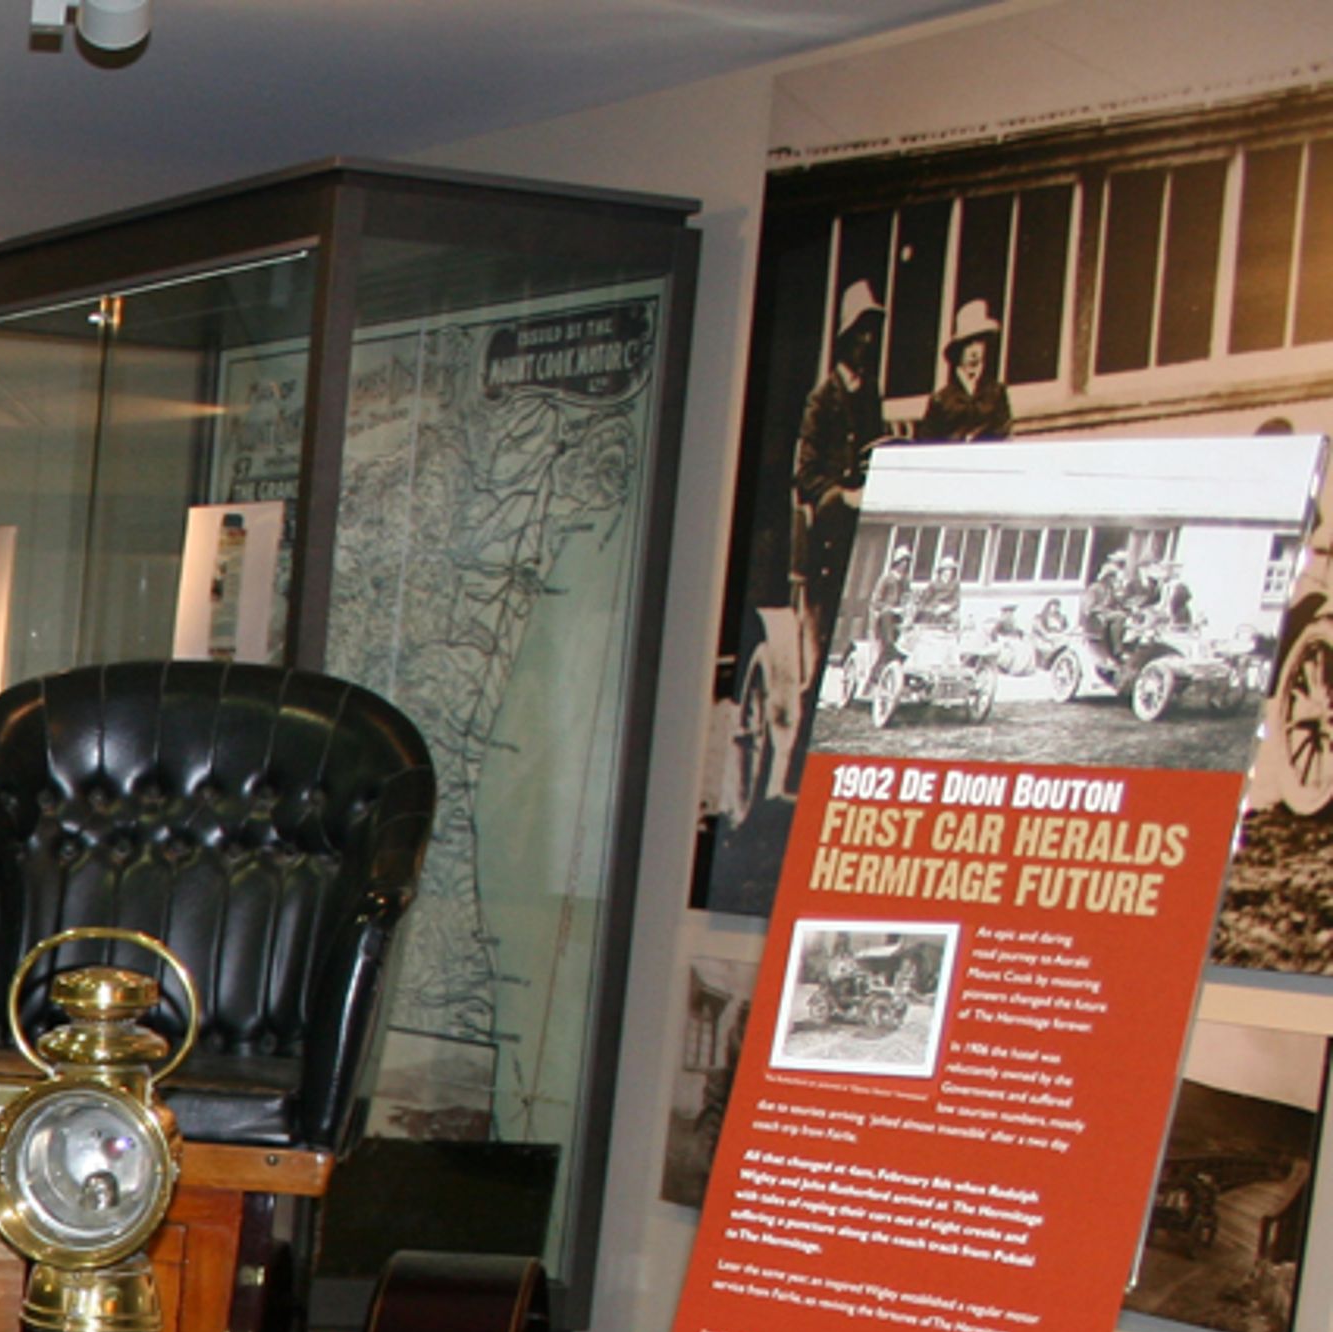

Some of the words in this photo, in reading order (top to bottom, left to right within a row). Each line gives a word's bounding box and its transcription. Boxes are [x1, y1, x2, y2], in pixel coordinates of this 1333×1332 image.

[832, 764, 894, 799] 1902
[820, 802, 924, 849] FIRST
[931, 811, 1005, 855] CAR
[1012, 815, 1189, 868] HERALDS
[809, 847, 1007, 904] HERMITAGE
[1014, 865, 1164, 917] FUTURE
[976, 926, 992, 938] An
[1018, 930, 1038, 943] and
[1040, 932, 1072, 948] daring
[972, 948, 997, 959] road
[997, 951, 1037, 966] journey
[1040, 955, 1053, 965] to
[967, 966, 1001, 981] Mount
[1003, 969, 1032, 984] Cook
[1035, 973, 1048, 988] by
[1050, 977, 1101, 994] motoring
[962, 989, 1007, 1003] pioneers
[1009, 992, 1052, 1009] changed
[1053, 997, 1071, 1009] the
[1074, 998, 1107, 1013] future
[957, 1008, 971, 1020] of
[975, 1008, 993, 1022] The
[995, 1012, 1050, 1031] Hermitage
[950, 1040, 960, 1052] In
[990, 1046, 1008, 1058] the
[1010, 1048, 1039, 1061] hotel
[1040, 1054, 1061, 1064] was
[944, 1062, 999, 1080] reluctantly
[1000, 1068, 1038, 1083] owned
[1038, 1073, 1051, 1087] by
[1053, 1074, 1073, 1088] the
[940, 1081, 1005, 1101] Government
[1007, 1090, 1029, 1103] and
[1029, 1092, 1074, 1109] suffered
[752, 1120, 779, 1131] coach
[801, 1124, 824, 1138] from
[757, 1099, 775, 1111] due
[776, 1102, 788, 1113] to
[790, 1104, 826, 1118] tourists
[828, 1109, 865, 1126] arriving
[990, 1130, 1017, 1144] after
[1018, 1136, 1024, 1145] a
[1027, 1136, 1048, 1148] two
[1050, 1139, 1070, 1153] day
[936, 1101, 954, 1114] low
[957, 1106, 998, 1120] tourism
[1049, 1118, 1086, 1134] mostly
[743, 1149, 760, 1161] All
[761, 1152, 785, 1165] that
[787, 1155, 833, 1173] changed
[834, 1164, 846, 1175] at
[877, 1167, 929, 1189] February
[954, 1181, 986, 1195] when
[739, 1167, 777, 1186] Wigley
[778, 1176, 801, 1188] and
[800, 1178, 826, 1192] John
[827, 1180, 891, 1202] Rutherford
[892, 1193, 935, 1209] arrived
[935, 1200, 949, 1211] at
[953, 1200, 976, 1214] The
[977, 1204, 1044, 1228] Hermitage
[730, 1208, 776, 1227] suffering
[784, 1218, 836, 1235] puncture
[836, 1225, 869, 1244] along
[871, 1231, 890, 1243] the
[891, 1235, 927, 1249] coach
[928, 1240, 959, 1255] track
[962, 1244, 991, 1260] from
[734, 1190, 758, 1203] with
[760, 1192, 786, 1207] tales
[786, 1196, 801, 1208] of
[800, 1201, 837, 1217] roping
[838, 1204, 867, 1218] their
[868, 1211, 892, 1223] cars
[893, 1215, 914, 1226] out
[915, 1217, 931, 1229] of
[931, 1221, 962, 1236] eight
[962, 1226, 1002, 1242] creeks
[1003, 1231, 1029, 1245] and
[724, 1228, 739, 1239] to
[739, 1227, 760, 1242] The
[712, 1280, 745, 1293] service
[746, 1284, 770, 1298] from
[805, 1297, 817, 1306] so
[818, 1299, 855, 1317] reviving
[856, 1305, 874, 1317] the
[874, 1307, 918, 1326] fortunes
[919, 1315, 933, 1328] of
[932, 1315, 952, 1331] The
[717, 1259, 741, 1272] Later
[743, 1263, 760, 1276] the
[761, 1268, 785, 1280] same
[810, 1277, 823, 1287] an
[824, 1278, 864, 1295] inspired
[865, 1284, 898, 1303] Wigley
[900, 1293, 957, 1311] established
[957, 1303, 964, 1312] a
[965, 1303, 1004, 1319] regular
[1004, 1310, 1041, 1325] motor
